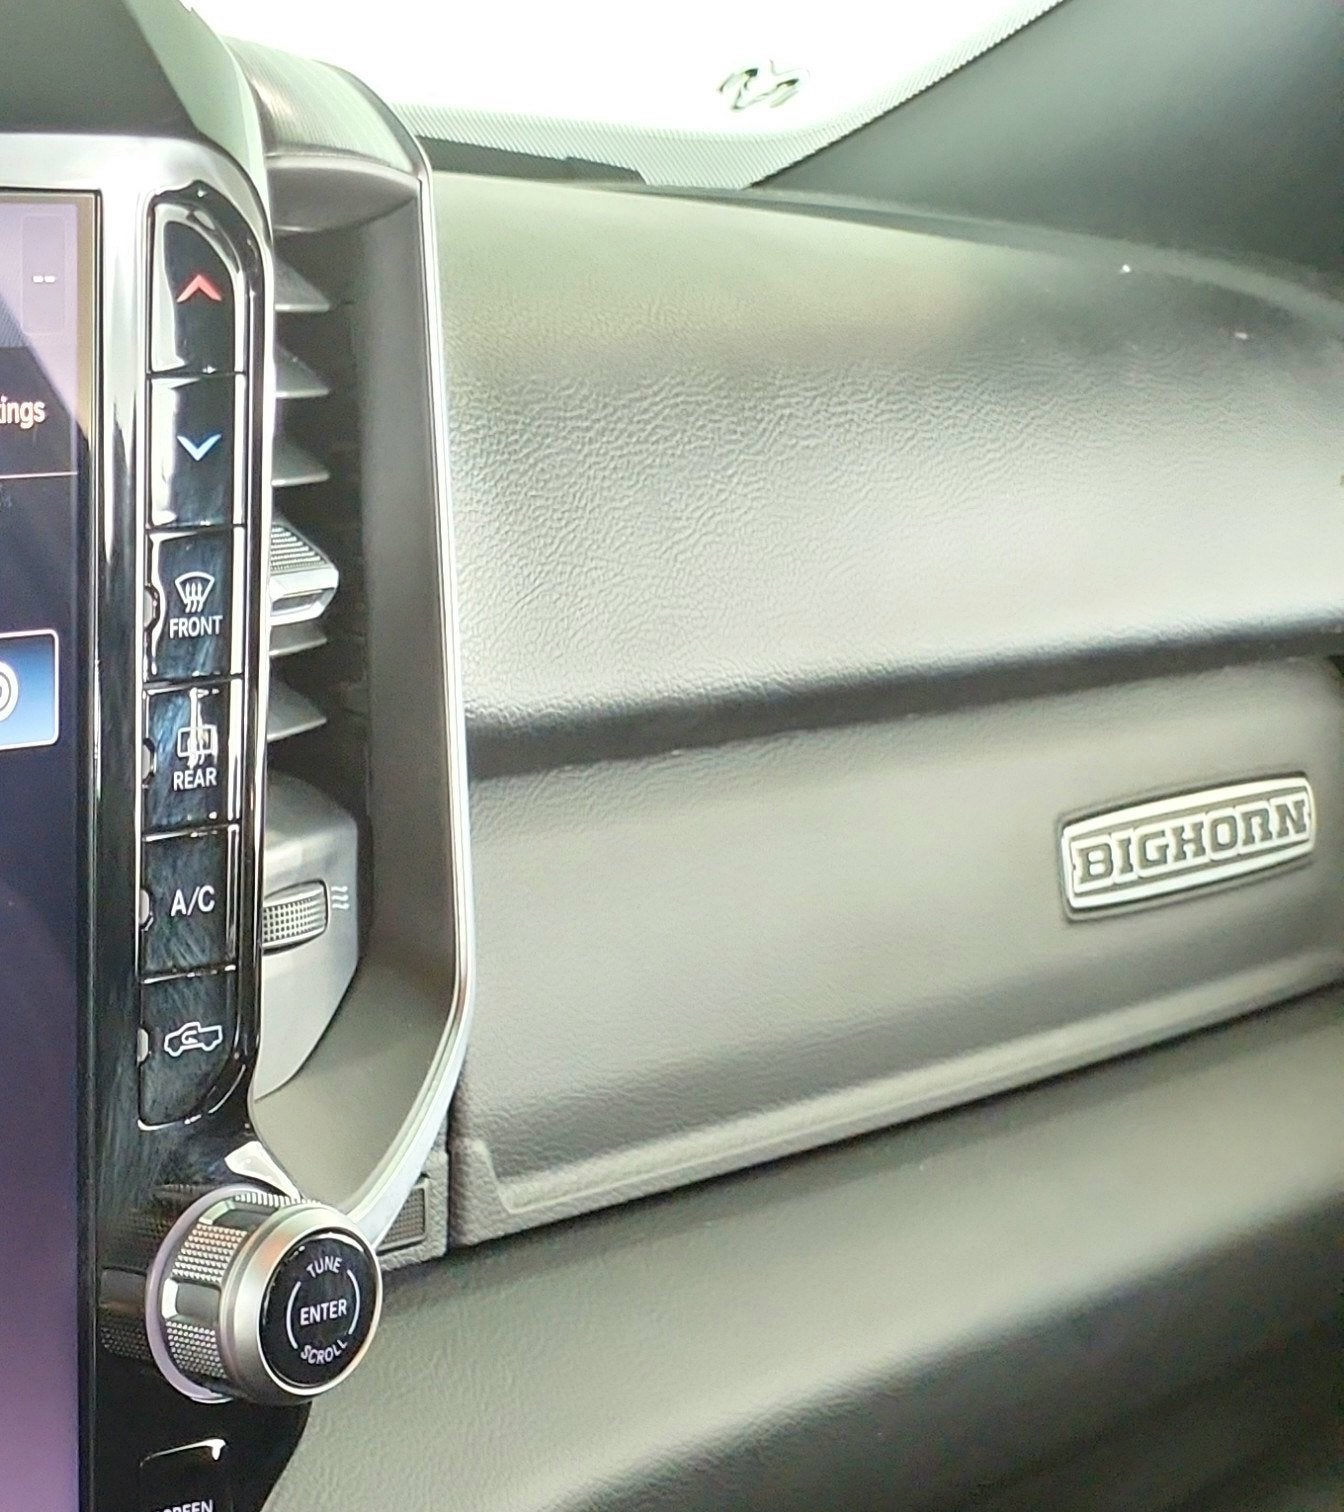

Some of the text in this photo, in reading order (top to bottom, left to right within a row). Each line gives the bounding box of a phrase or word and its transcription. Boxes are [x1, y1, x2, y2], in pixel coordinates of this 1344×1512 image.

[169, 615, 224, 640] FRONT
[172, 768, 218, 791] REAR
[1071, 790, 1311, 893] BIGHORN
[170, 884, 216, 917] A/C
[305, 1254, 343, 1280] TUNE
[299, 1298, 348, 1327] ENTER
[300, 1338, 348, 1366] SCROLL
